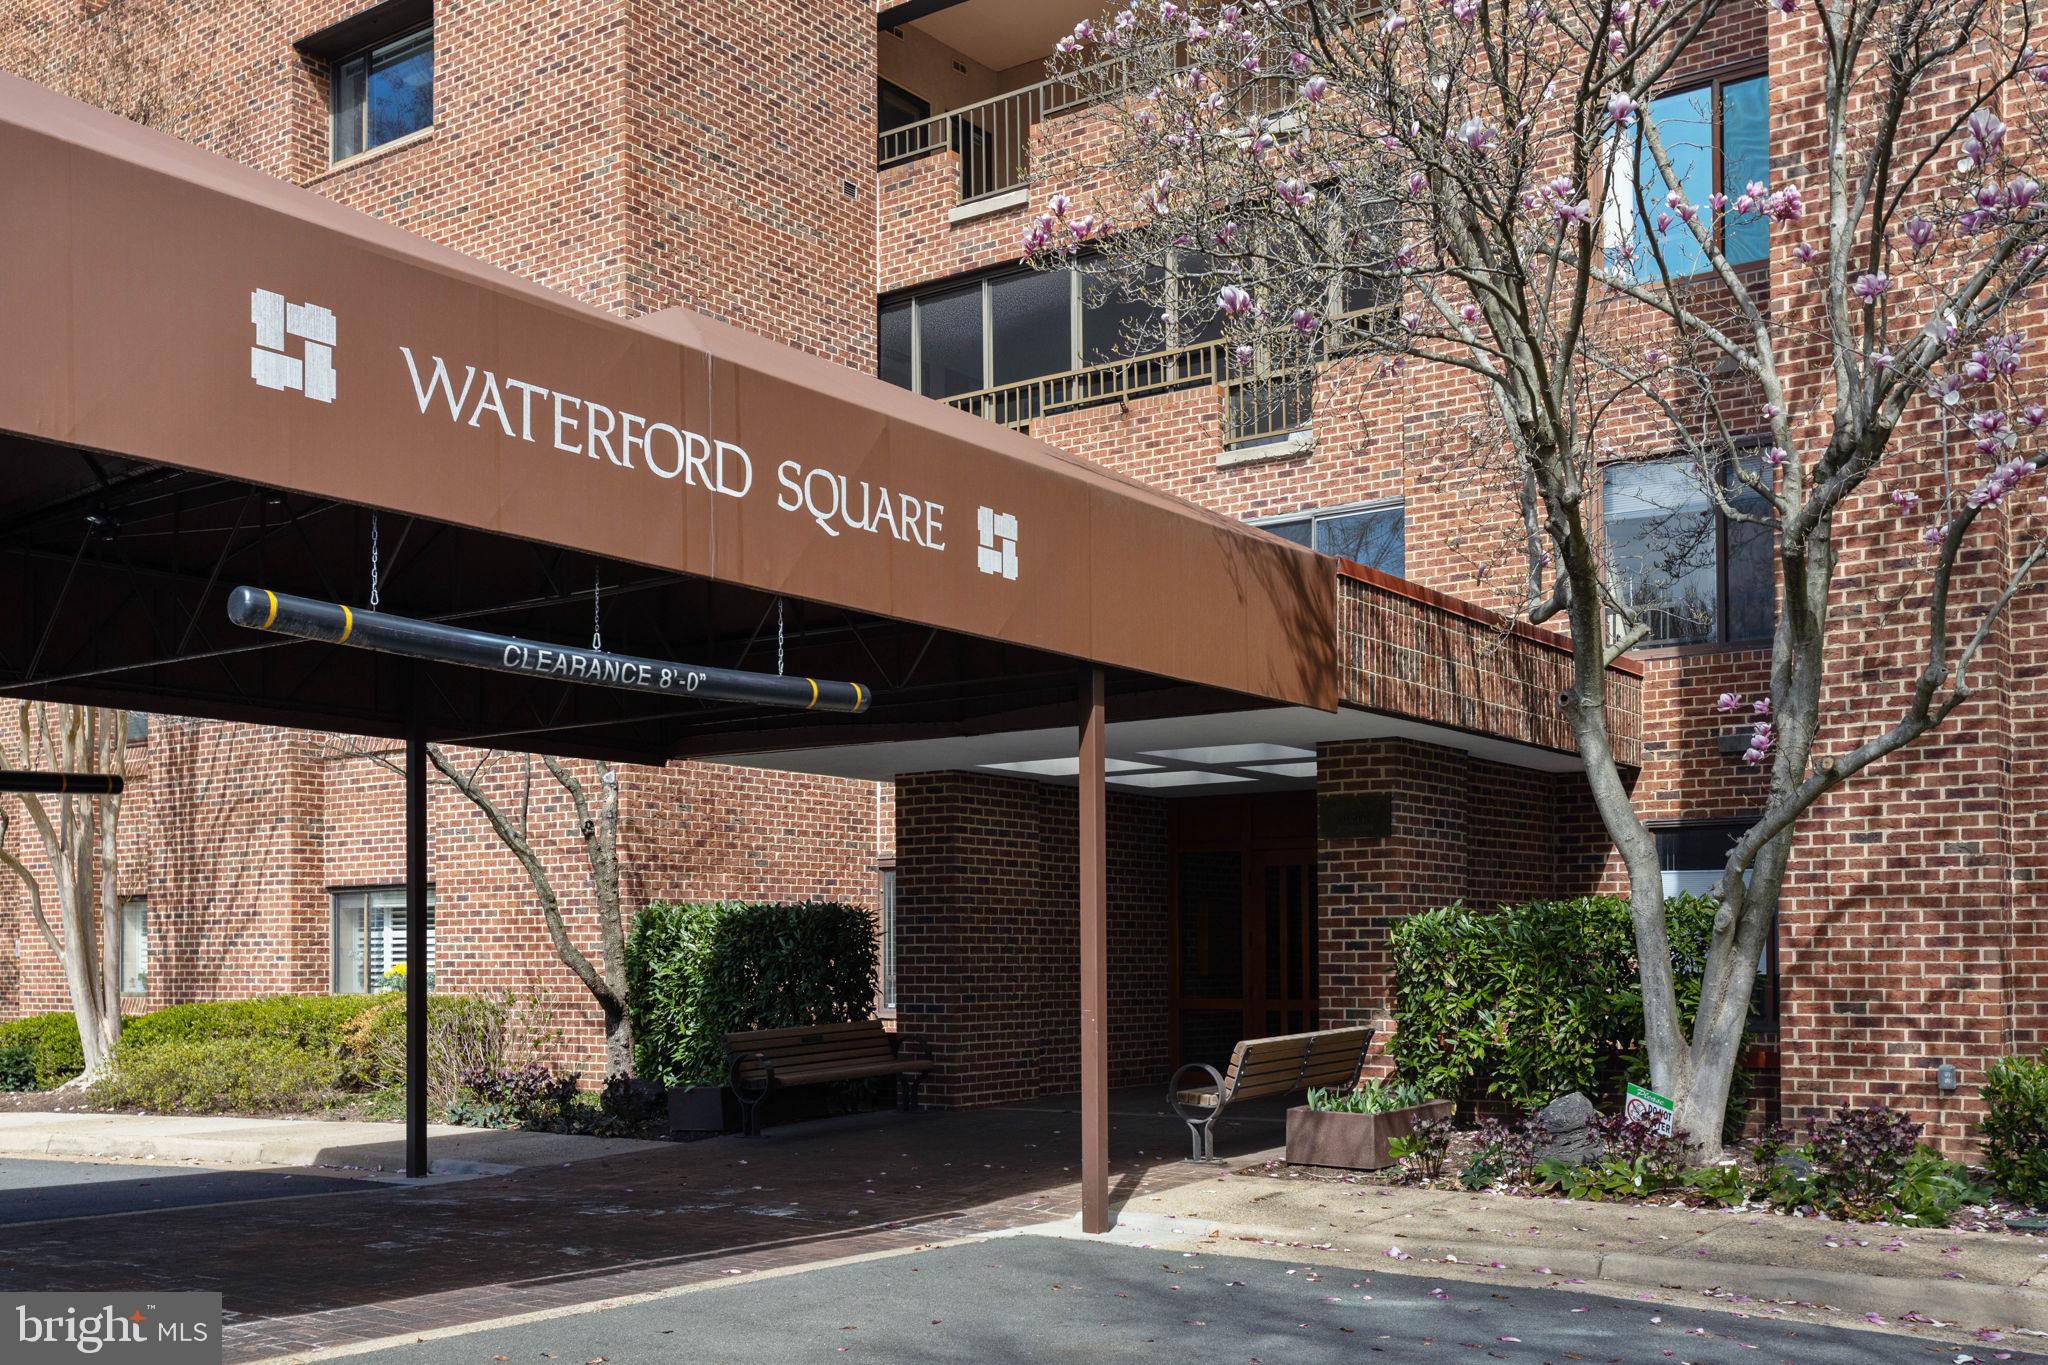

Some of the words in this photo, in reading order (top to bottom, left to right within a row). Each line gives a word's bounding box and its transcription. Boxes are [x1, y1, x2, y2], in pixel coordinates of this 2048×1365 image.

[400, 346, 752, 498] WATERFORD
[778, 460, 945, 552] SQUARE
[503, 645, 651, 686] CLEARANCE
[1637, 1089, 1664, 1105] Please
[1648, 1104, 1657, 1115] DO
